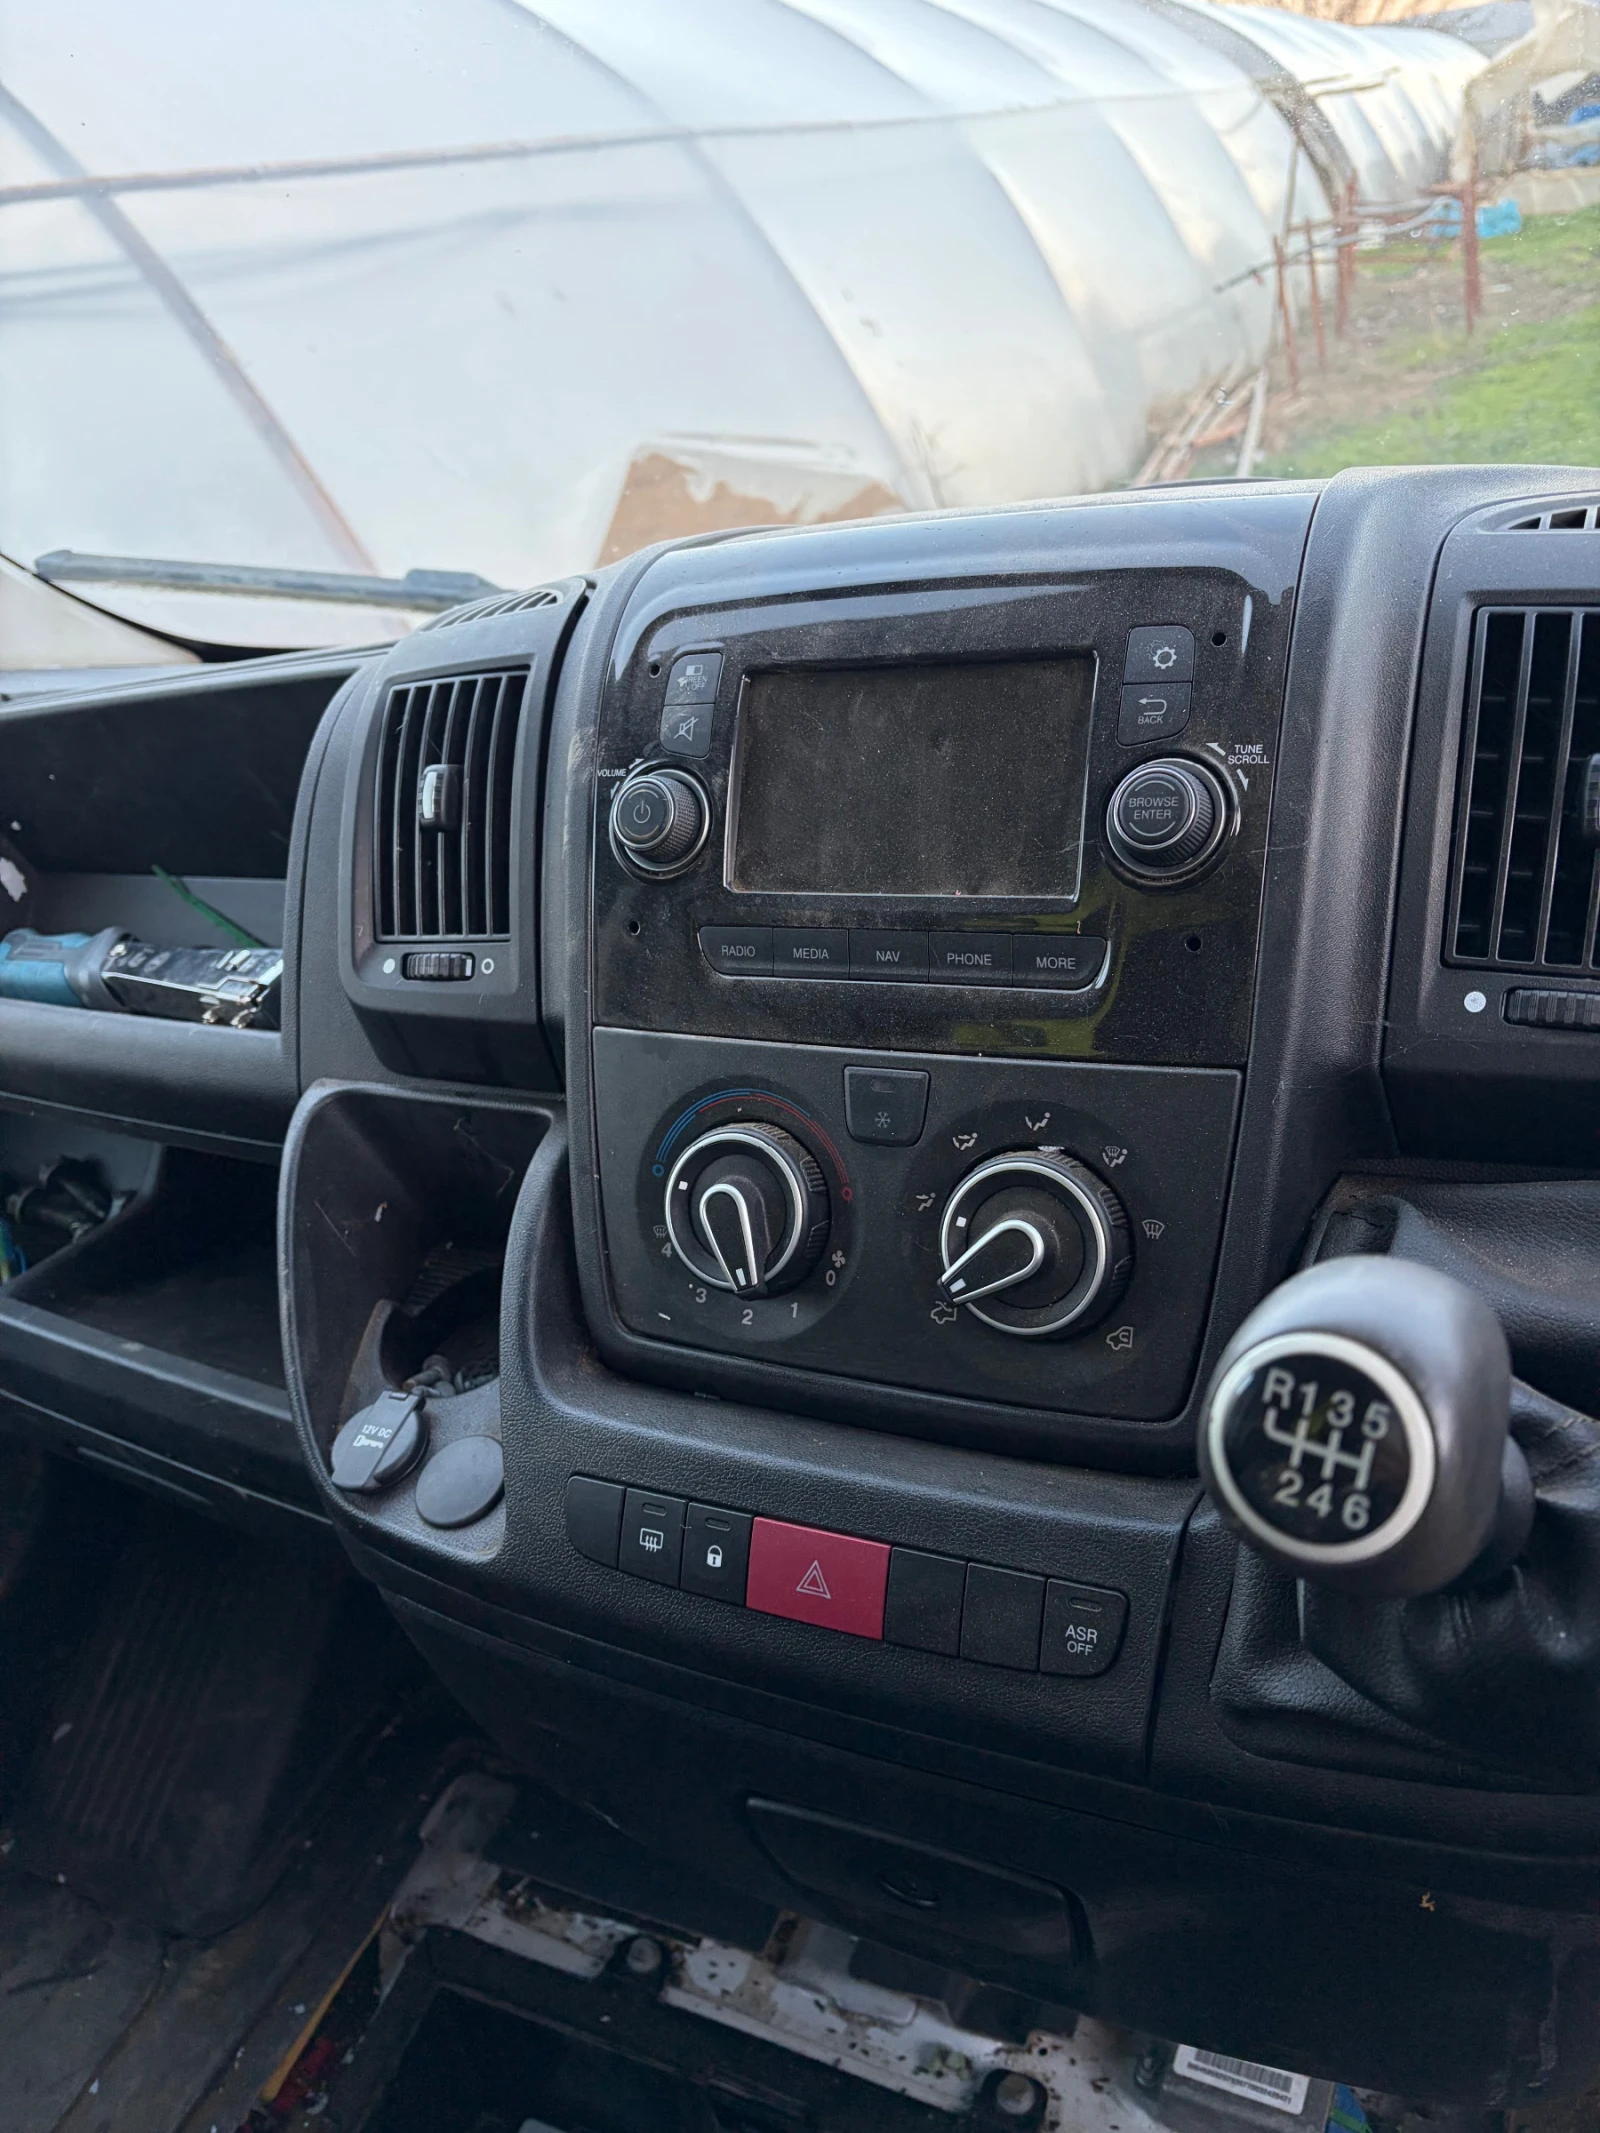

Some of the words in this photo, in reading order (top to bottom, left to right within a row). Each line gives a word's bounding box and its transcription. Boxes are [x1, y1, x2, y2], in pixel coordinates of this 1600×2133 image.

[1137, 715, 1163, 725] BACK
[1234, 744, 1263, 754] TUNE
[1227, 754, 1270, 765] SCROLL
[596, 768, 627, 777] VOLUME
[1128, 796, 1179, 808] BROWSE
[1133, 809, 1172, 820] ENTER
[721, 945, 756, 958] RADIO
[792, 947, 830, 960] MEDIA
[875, 950, 900, 962] NAV
[946, 952, 992, 966] PHONE
[1035, 956, 1077, 970] MORE
[661, 1242, 673, 1258] 4
[825, 1270, 836, 1286] 0
[695, 1288, 707, 1303] 3
[741, 1309, 753, 1325] 2
[790, 1302, 798, 1318] 1
[1262, 1366, 1295, 1411] R
[1299, 1380, 1320, 1417] 1
[1325, 1389, 1356, 1428] 3
[1360, 1401, 1392, 1440] 5
[361, 1424, 380, 1435] 12V
[377, 1427, 392, 1438] DC
[1274, 1469, 1304, 1508] 2
[1305, 1481, 1334, 1519] 4
[1341, 1492, 1372, 1531] 6
[1064, 1624, 1098, 1644] ASR
[1066, 1640, 1094, 1656] OFF
